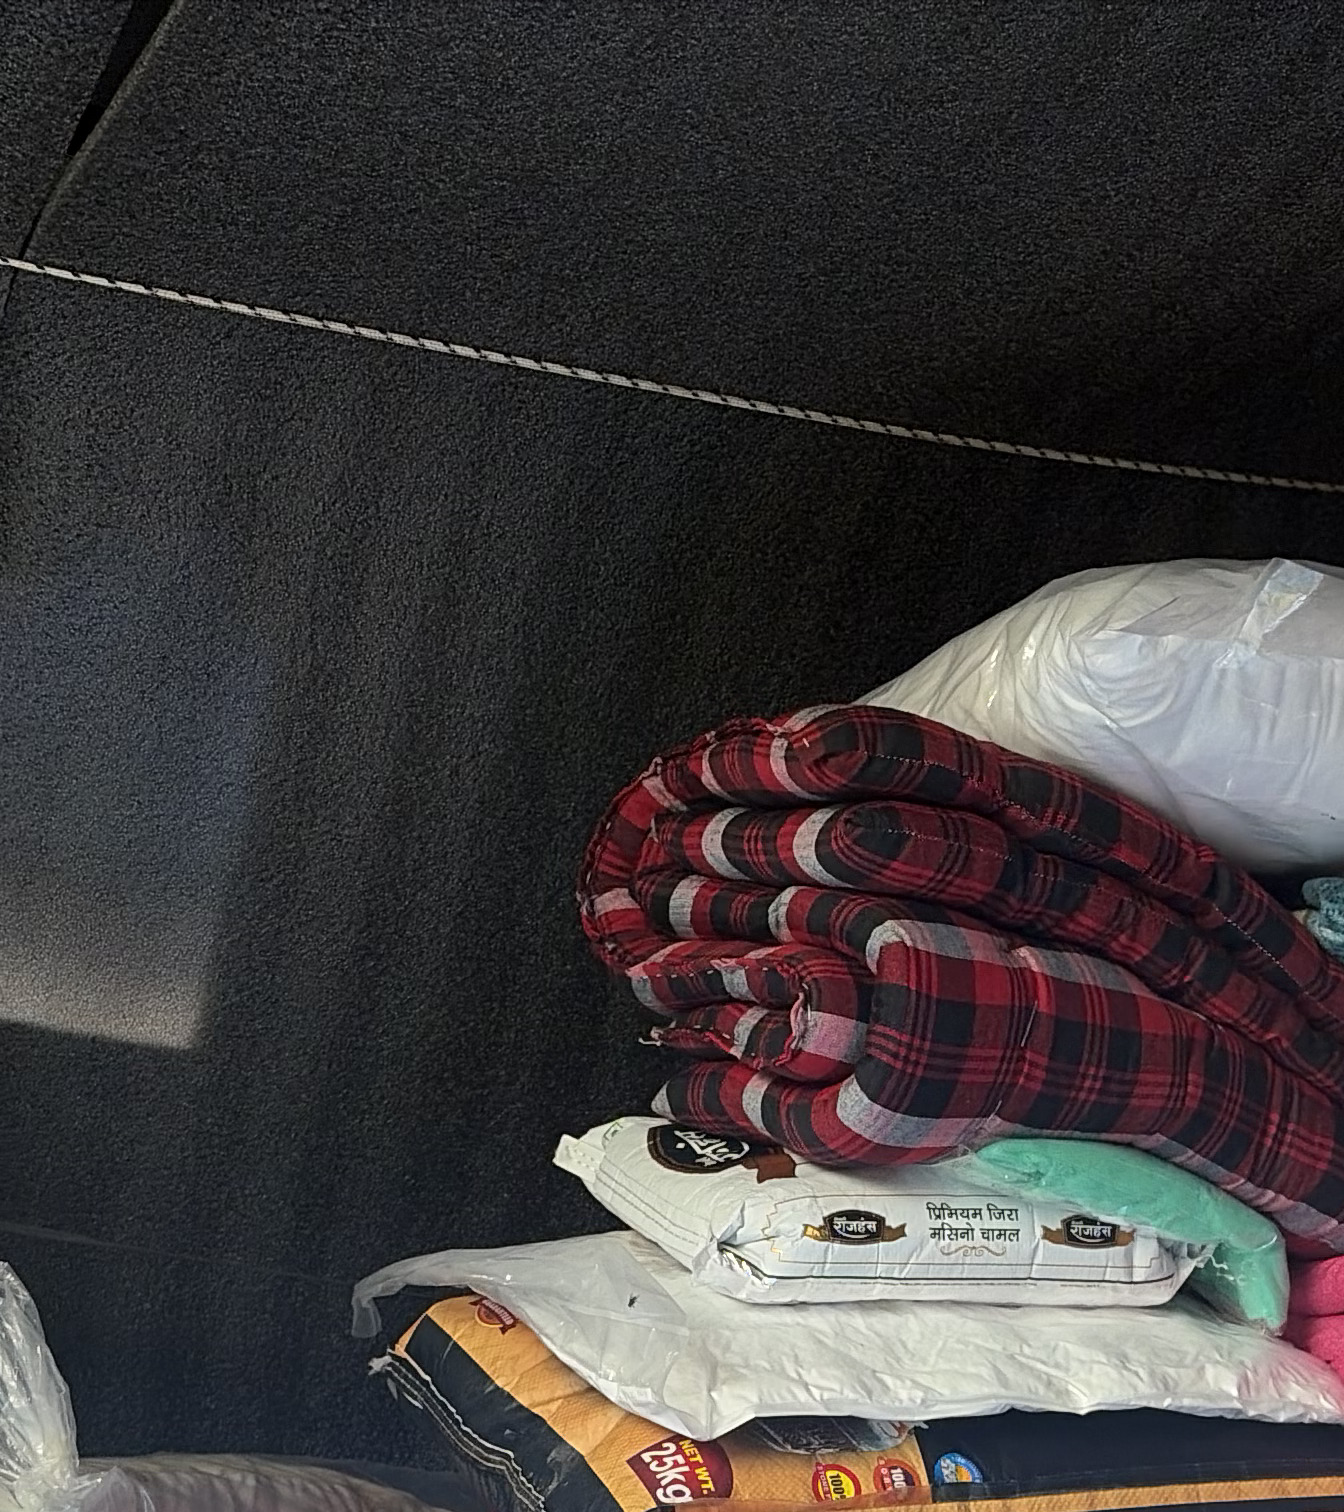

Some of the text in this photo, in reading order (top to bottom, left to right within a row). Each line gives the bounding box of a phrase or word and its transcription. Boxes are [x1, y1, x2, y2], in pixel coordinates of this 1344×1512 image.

[926, 1202, 1019, 1223] प्रिमियम जिरा
[929, 1223, 1020, 1243] मसिनो चामल
[640, 1441, 693, 1504] 25kg
[679, 1439, 717, 1495] NET WT.
